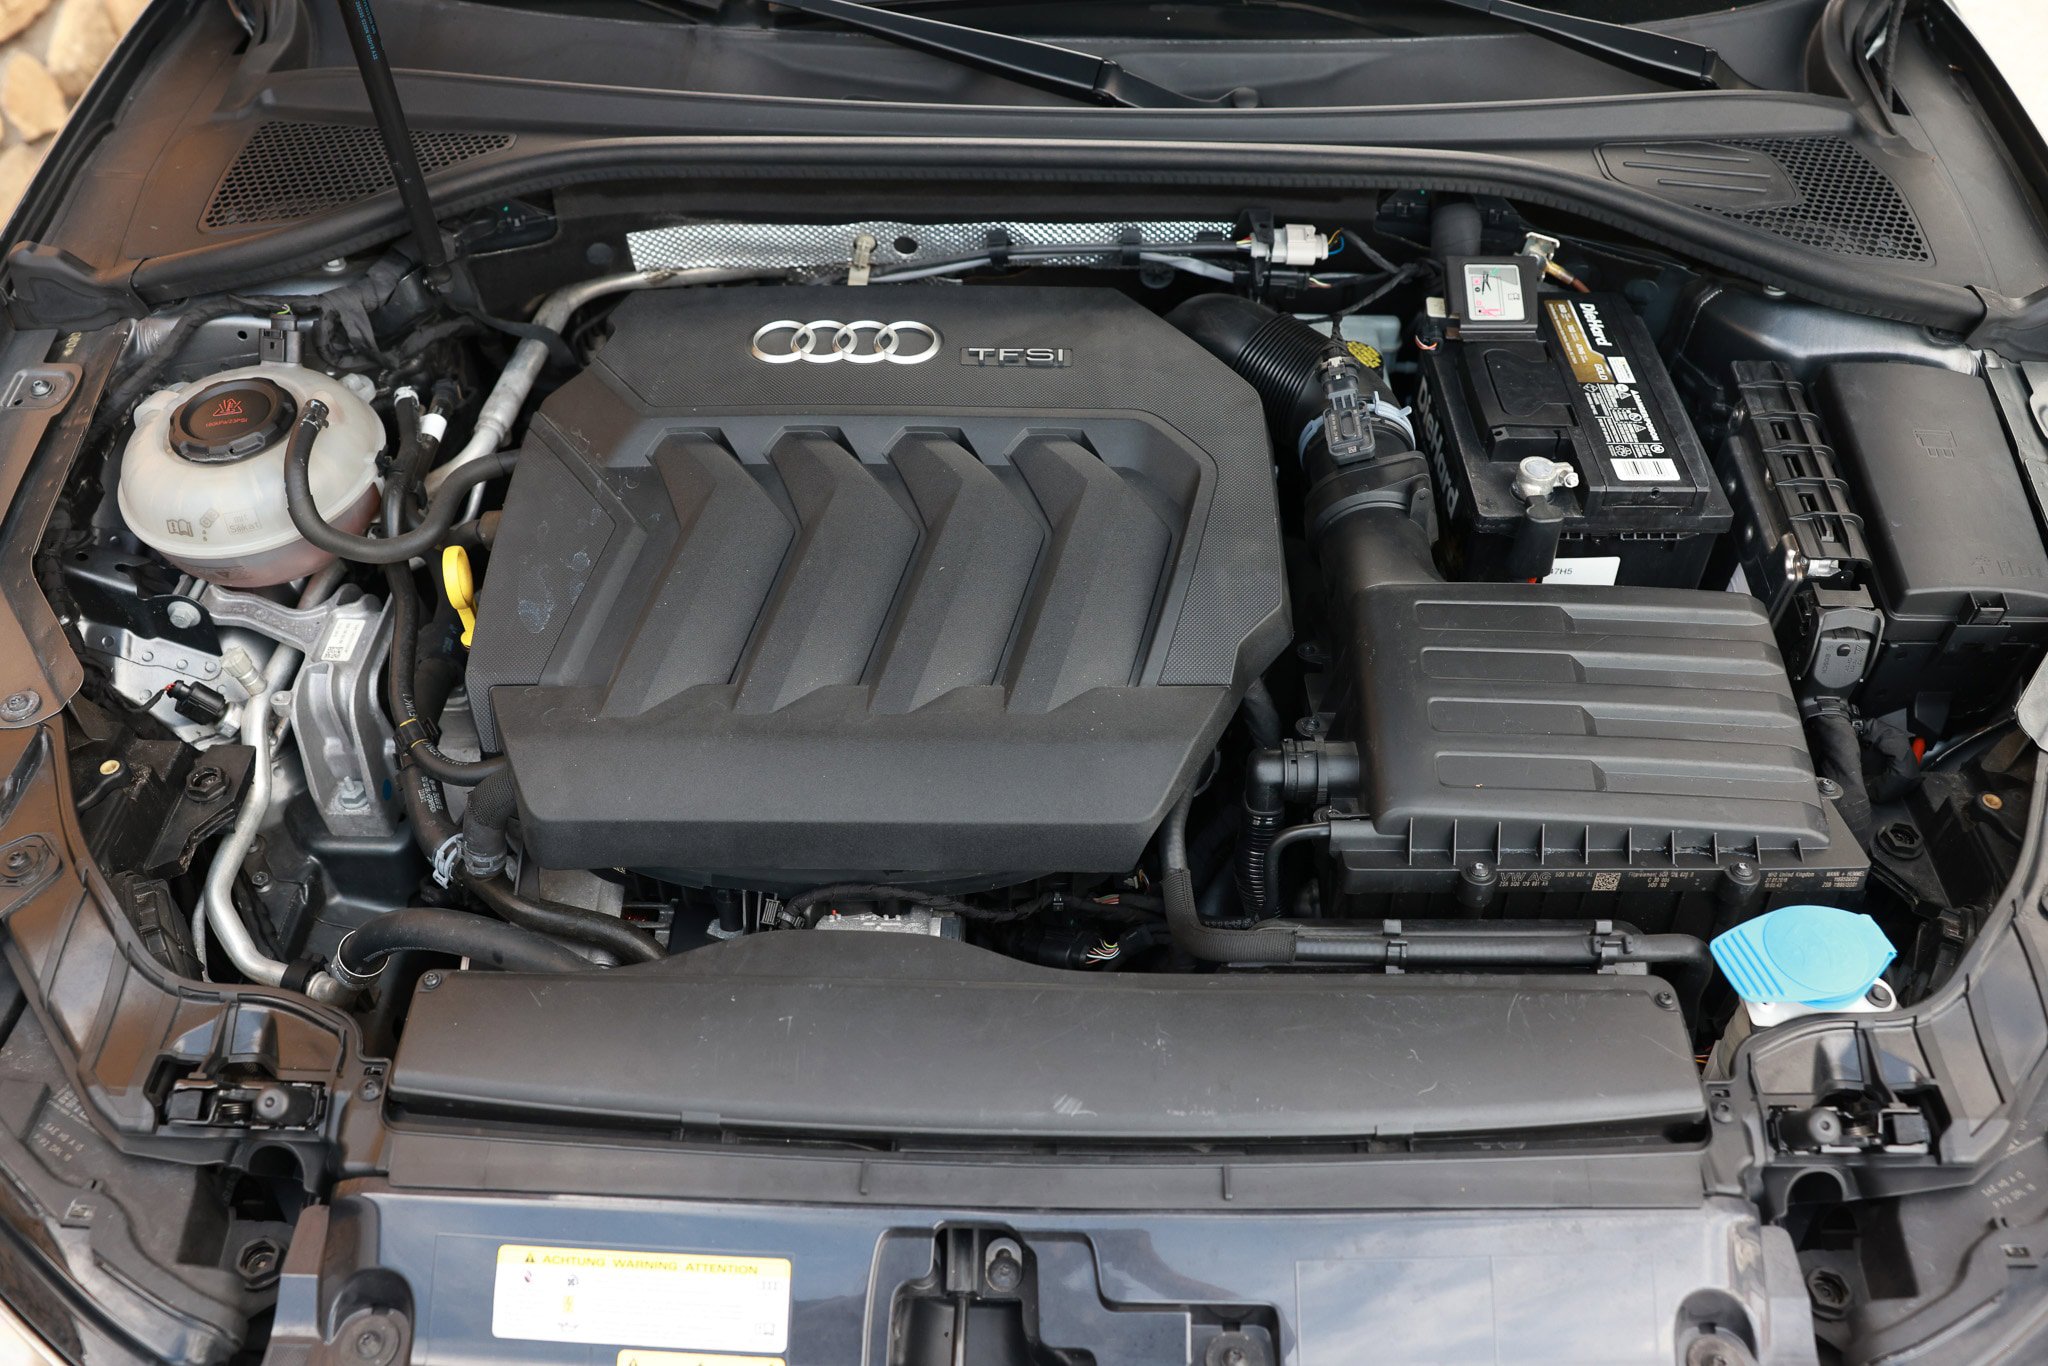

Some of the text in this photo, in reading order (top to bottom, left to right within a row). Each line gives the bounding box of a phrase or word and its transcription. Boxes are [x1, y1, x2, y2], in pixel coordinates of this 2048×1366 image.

[1579, 302, 1613, 347] DieHard
[968, 347, 1063, 361] TFSI
[1593, 364, 1609, 381] GOLD
[1416, 376, 1461, 519] DieHard
[1500, 872, 1551, 881] VW AG
[542, 1256, 759, 1275] ACHTUNG WARNING ATTENTION
